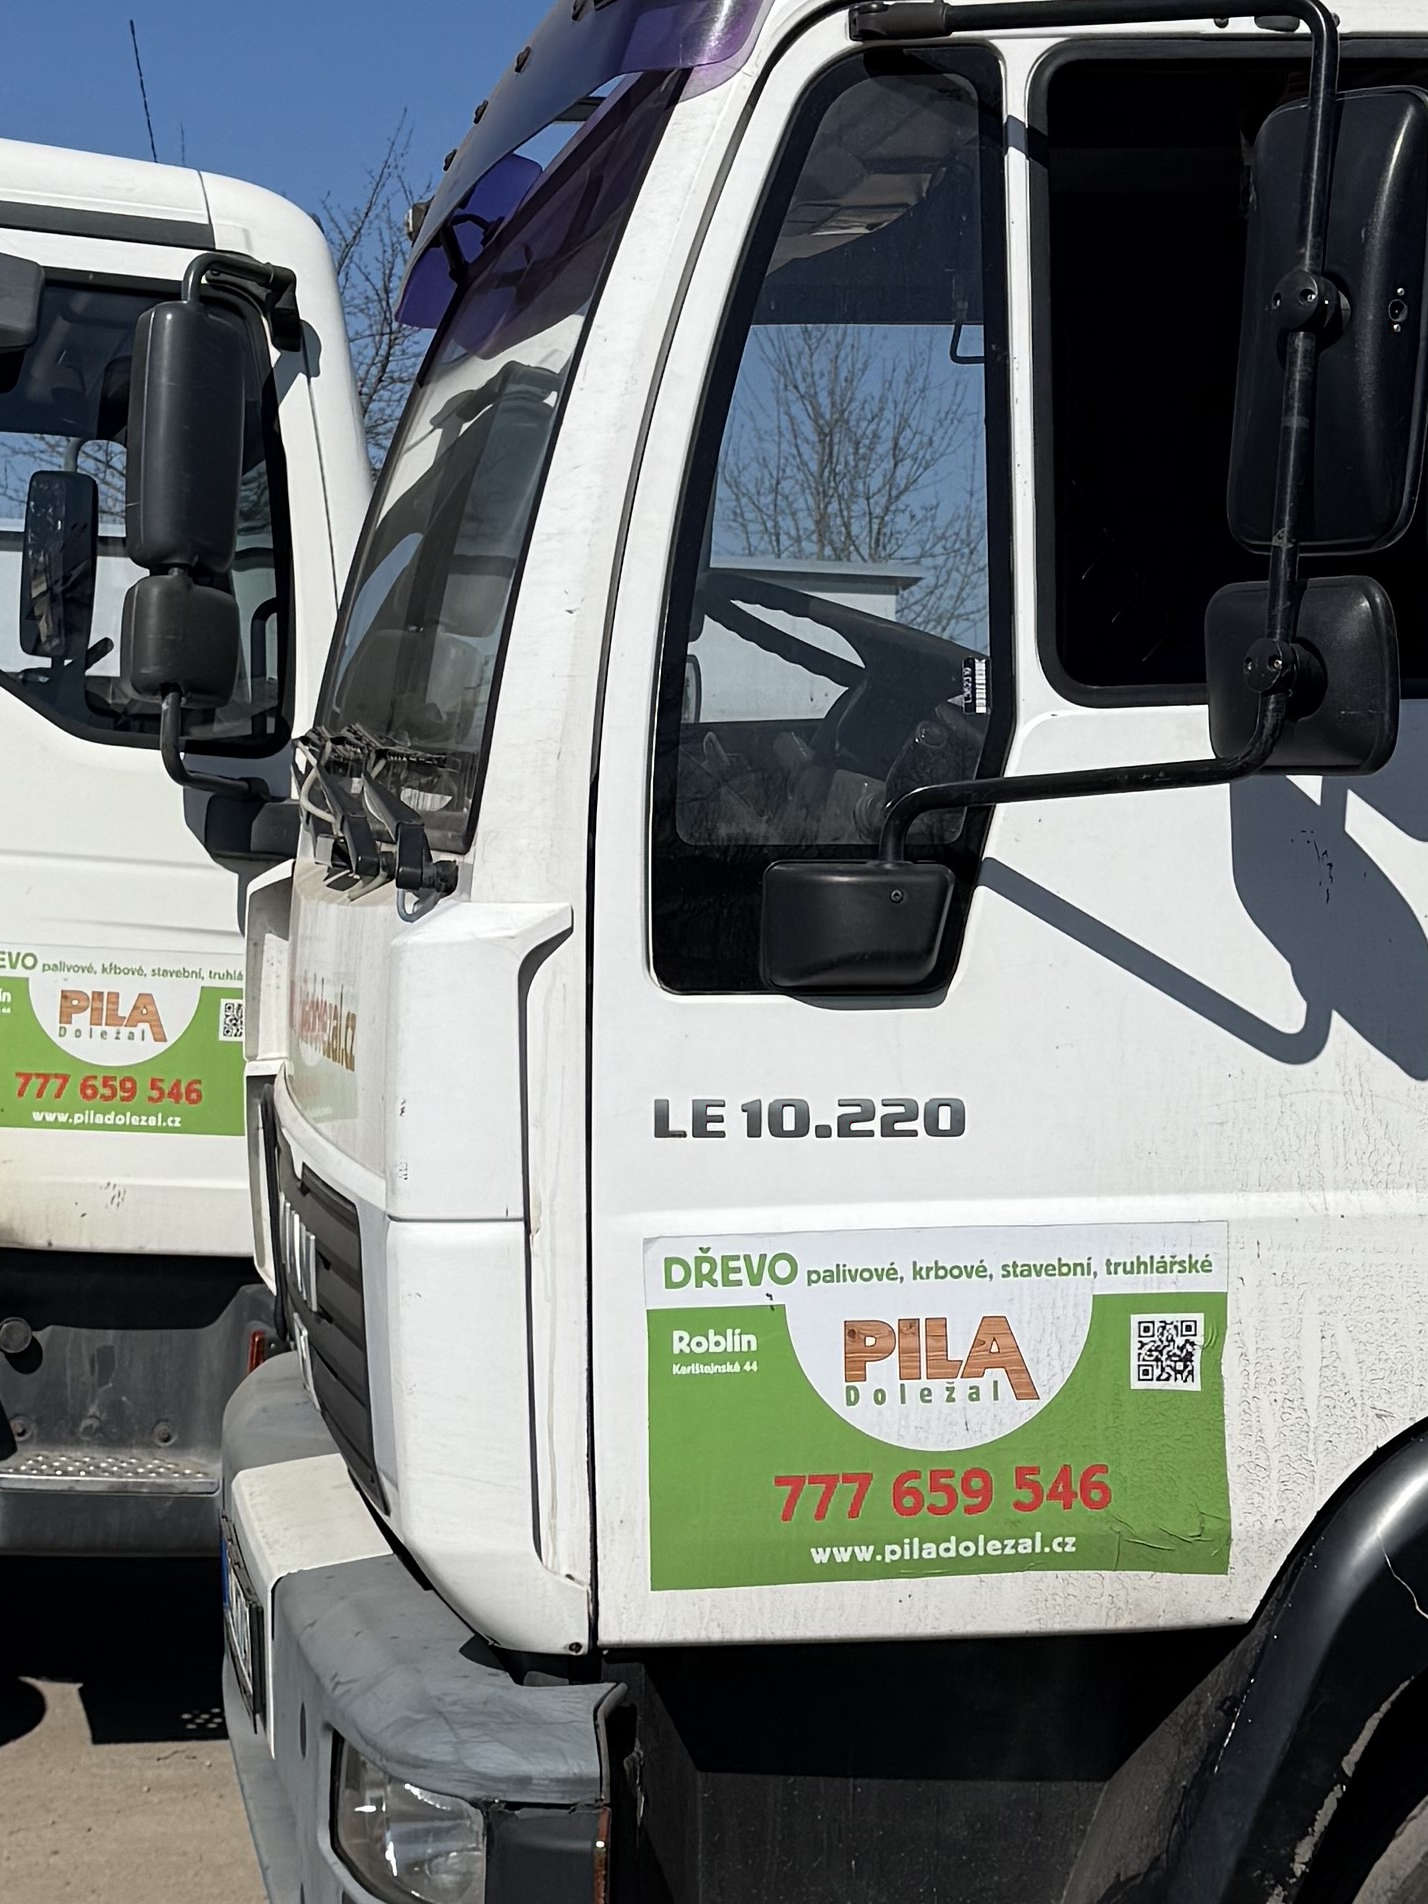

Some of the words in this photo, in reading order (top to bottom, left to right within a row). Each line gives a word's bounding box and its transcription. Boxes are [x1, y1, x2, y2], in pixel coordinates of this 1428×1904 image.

[208, 969, 243, 982] truhlá
[59, 989, 168, 1043] PILA
[58, 1025, 146, 1042] Doležal
[15, 1072, 71, 1099] 777
[79, 1075, 138, 1103] 659
[147, 1077, 204, 1106] 546
[32, 1109, 181, 1127] www.piladolezal.cz
[653, 1098, 726, 1139] LE
[741, 1097, 967, 1139] 10.220
[664, 1246, 798, 1289] DŘEVO
[806, 1262, 904, 1287] palivové,
[912, 1259, 993, 1282] krbové,
[1001, 1256, 1098, 1280] stavební,
[1105, 1253, 1213, 1276] truhlářské
[672, 1328, 758, 1354] Roblín
[843, 1315, 1041, 1401] PILA
[845, 1380, 1000, 1407] Doležal
[774, 1472, 873, 1522] 777
[892, 1467, 994, 1517] 659
[1013, 1464, 1113, 1512] 546
[810, 1533, 1078, 1565] www.piladolezal.cz
